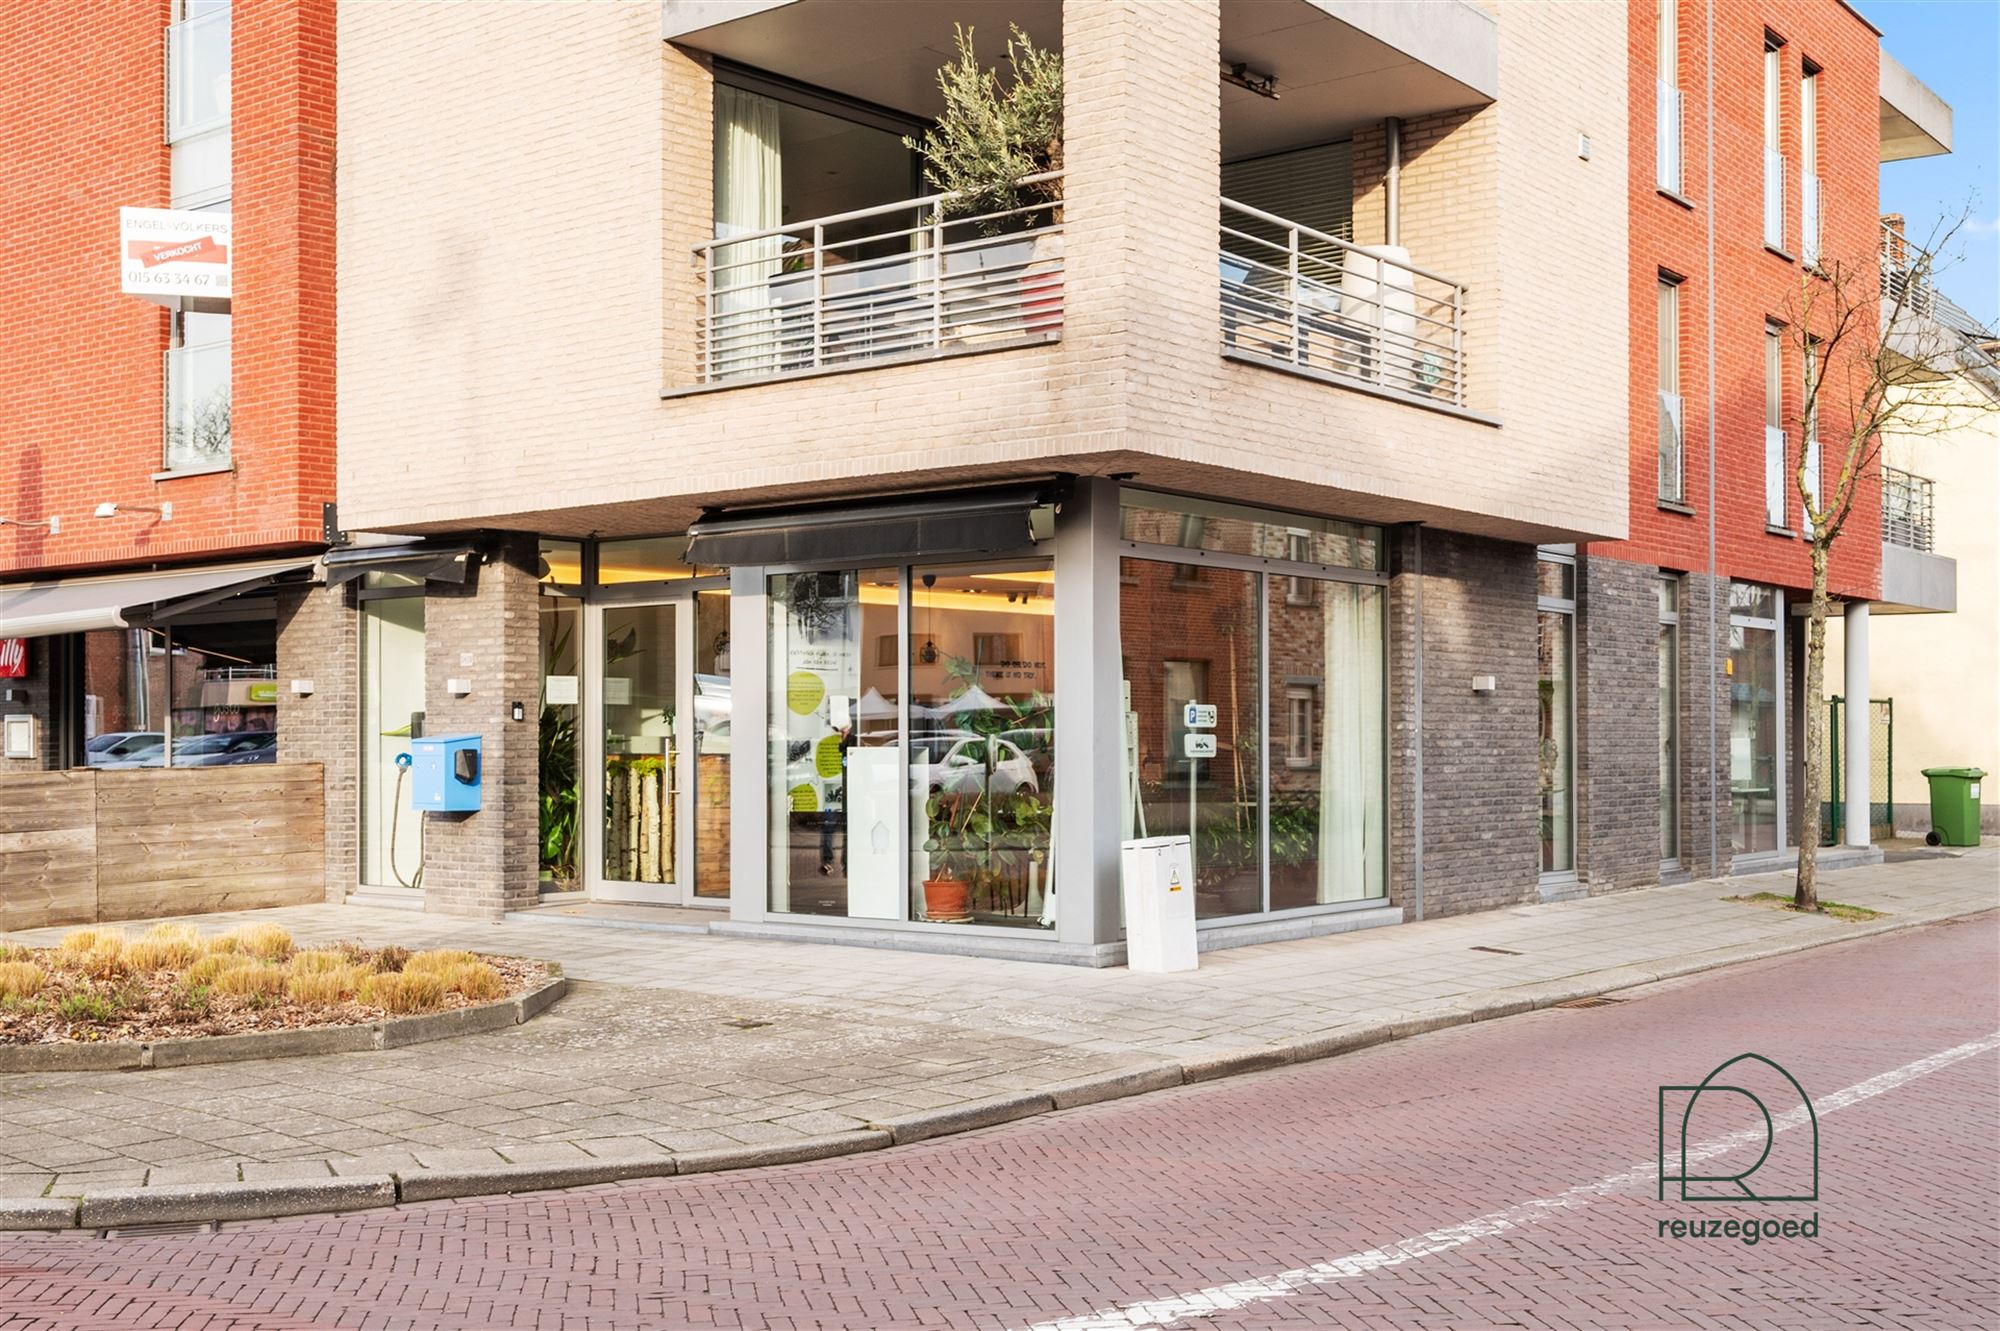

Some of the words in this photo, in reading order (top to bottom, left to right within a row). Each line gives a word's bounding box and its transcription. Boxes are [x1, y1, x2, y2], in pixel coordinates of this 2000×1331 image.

[153, 242, 202, 260] VERKOCHT
[128, 271, 151, 284] 015
[154, 271, 171, 285] 63
[174, 273, 190, 286] 34
[194, 274, 210, 286] 67
